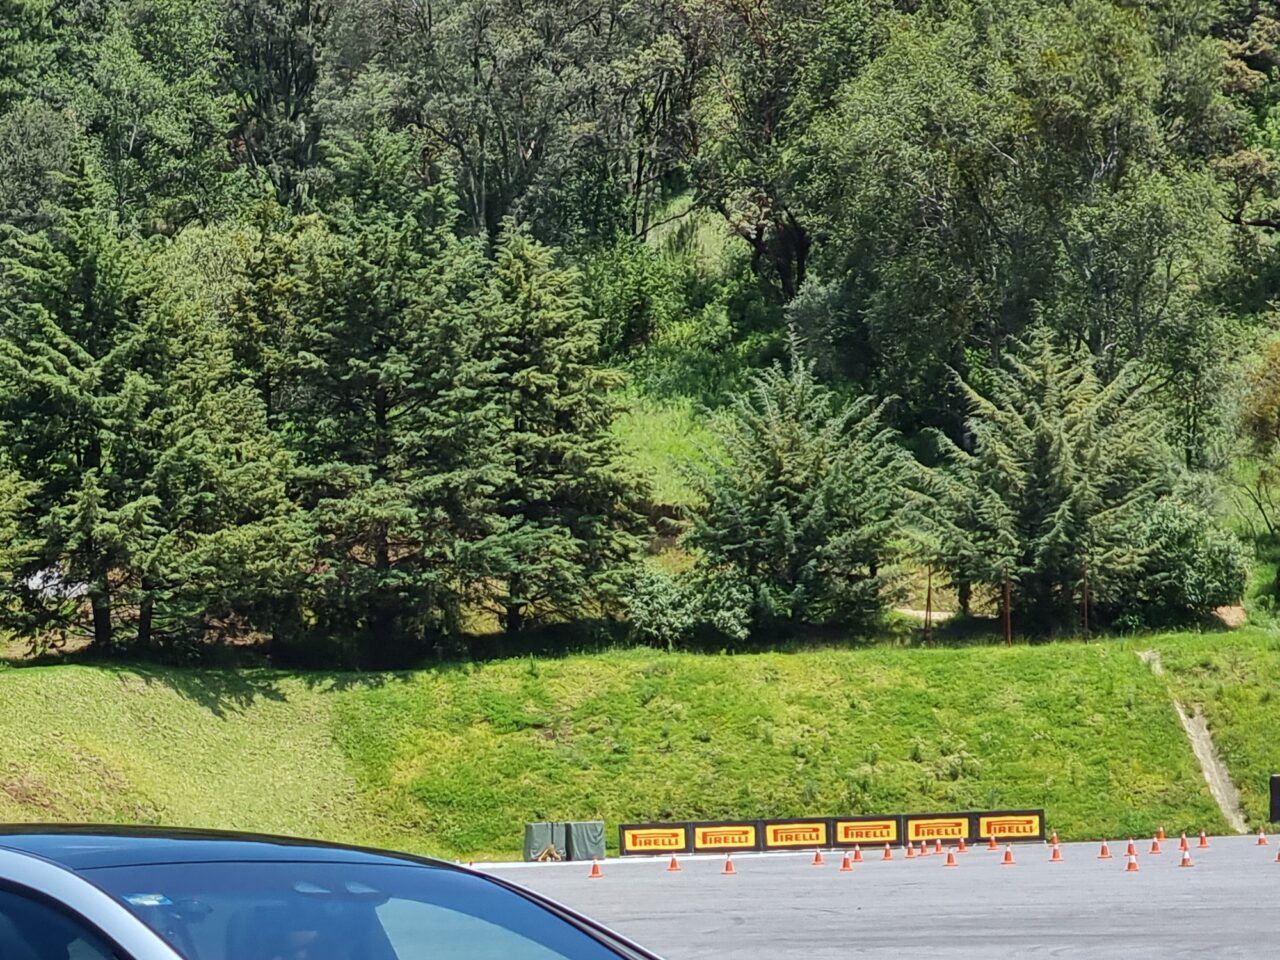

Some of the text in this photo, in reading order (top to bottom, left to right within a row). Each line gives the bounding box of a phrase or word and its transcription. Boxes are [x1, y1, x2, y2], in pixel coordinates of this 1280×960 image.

[773, 827, 820, 842] PIRELLI
[843, 824, 891, 839] PIRELLI
[914, 821, 963, 837] PIRELLI
[986, 819, 1034, 835] PIRELLI
[631, 832, 680, 847] PIRELLI
[701, 830, 750, 845] PIRELLI
